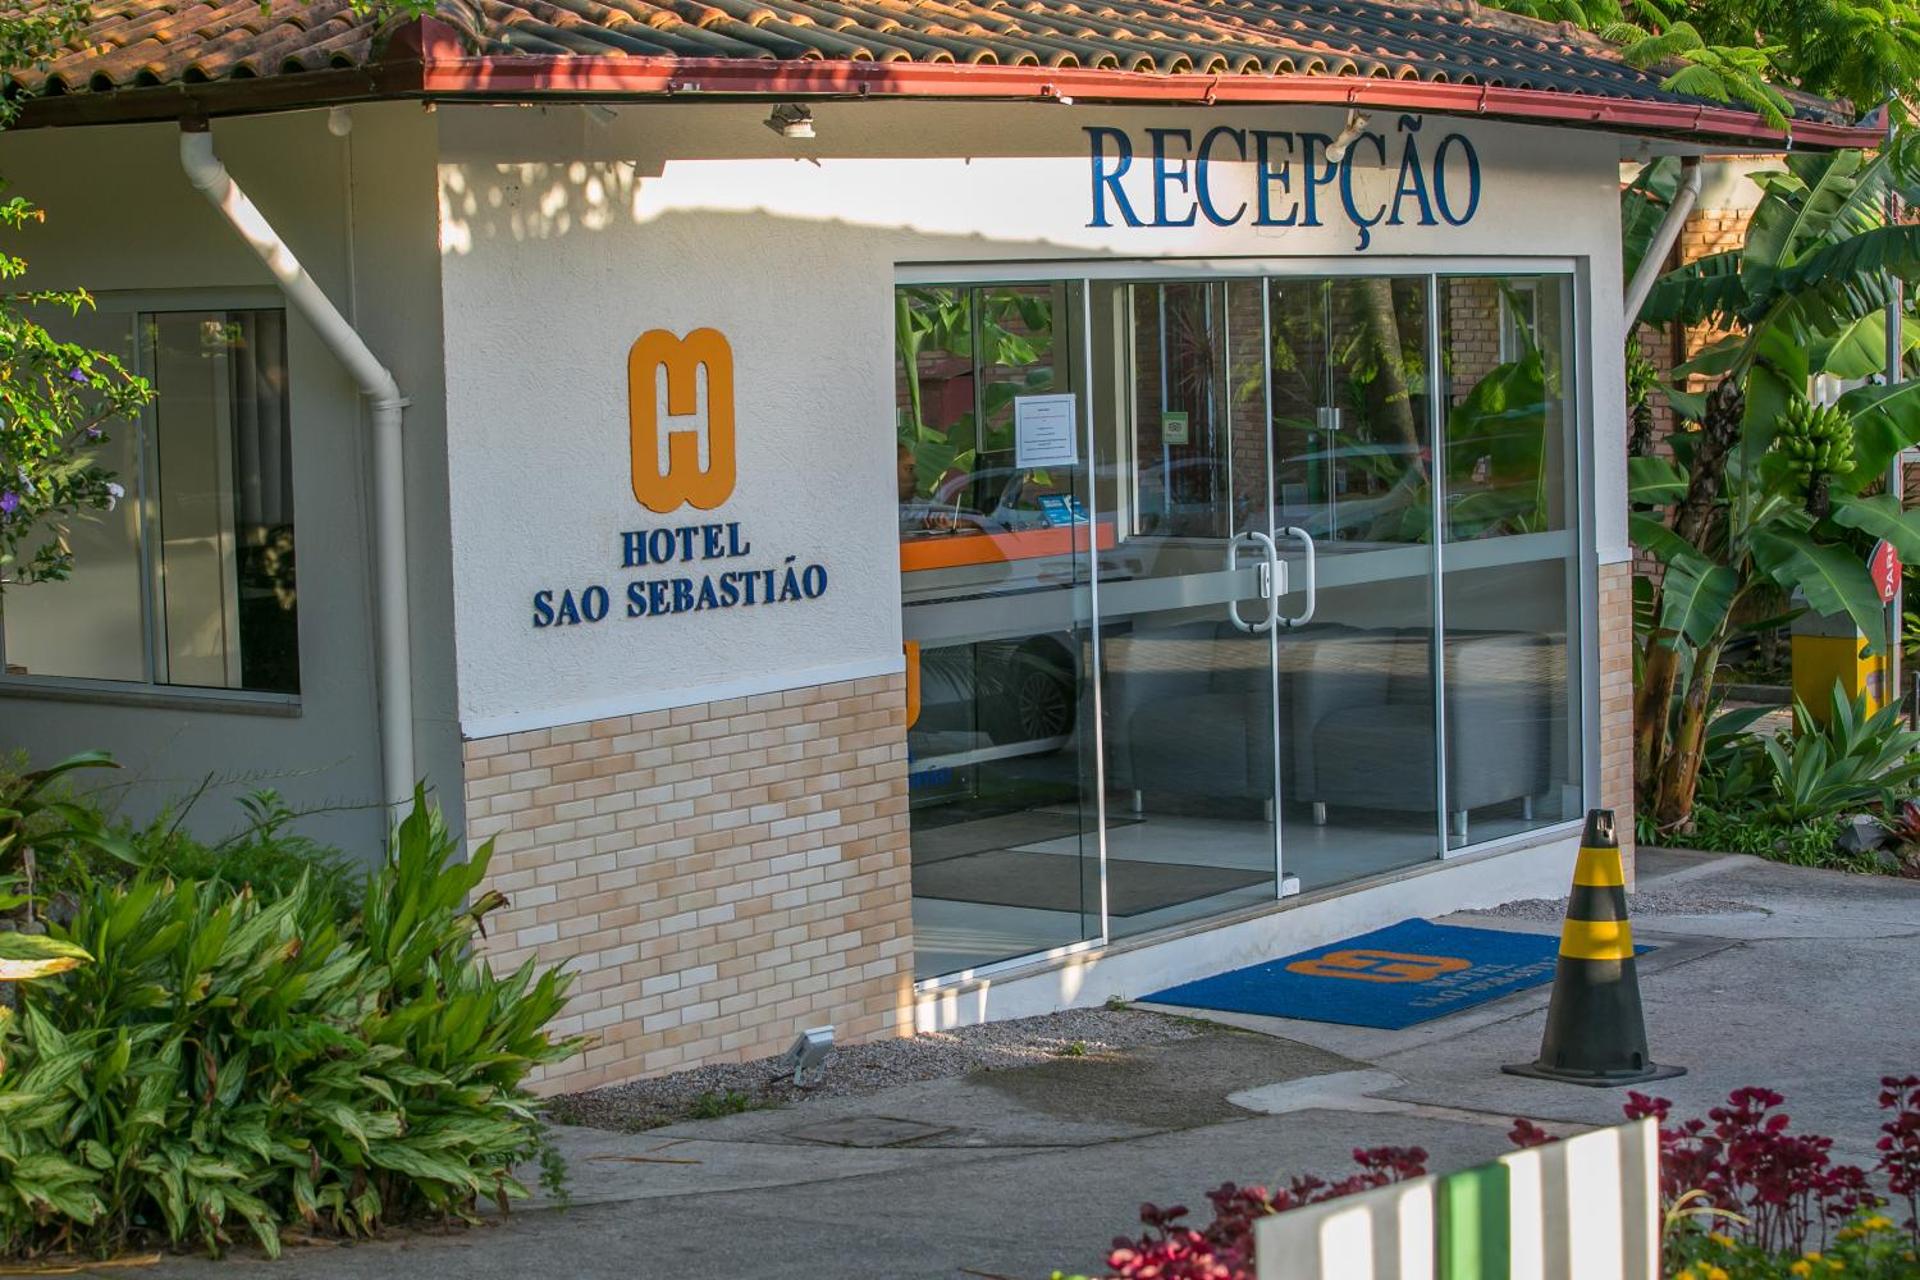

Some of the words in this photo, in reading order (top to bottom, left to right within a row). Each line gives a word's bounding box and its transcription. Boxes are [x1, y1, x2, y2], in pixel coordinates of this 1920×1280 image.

[1082, 114, 1481, 251] RECEPÇÃO
[620, 522, 751, 568] HOTEL
[533, 585, 610, 628] SAO
[626, 555, 828, 618] SEBASTIÃO
